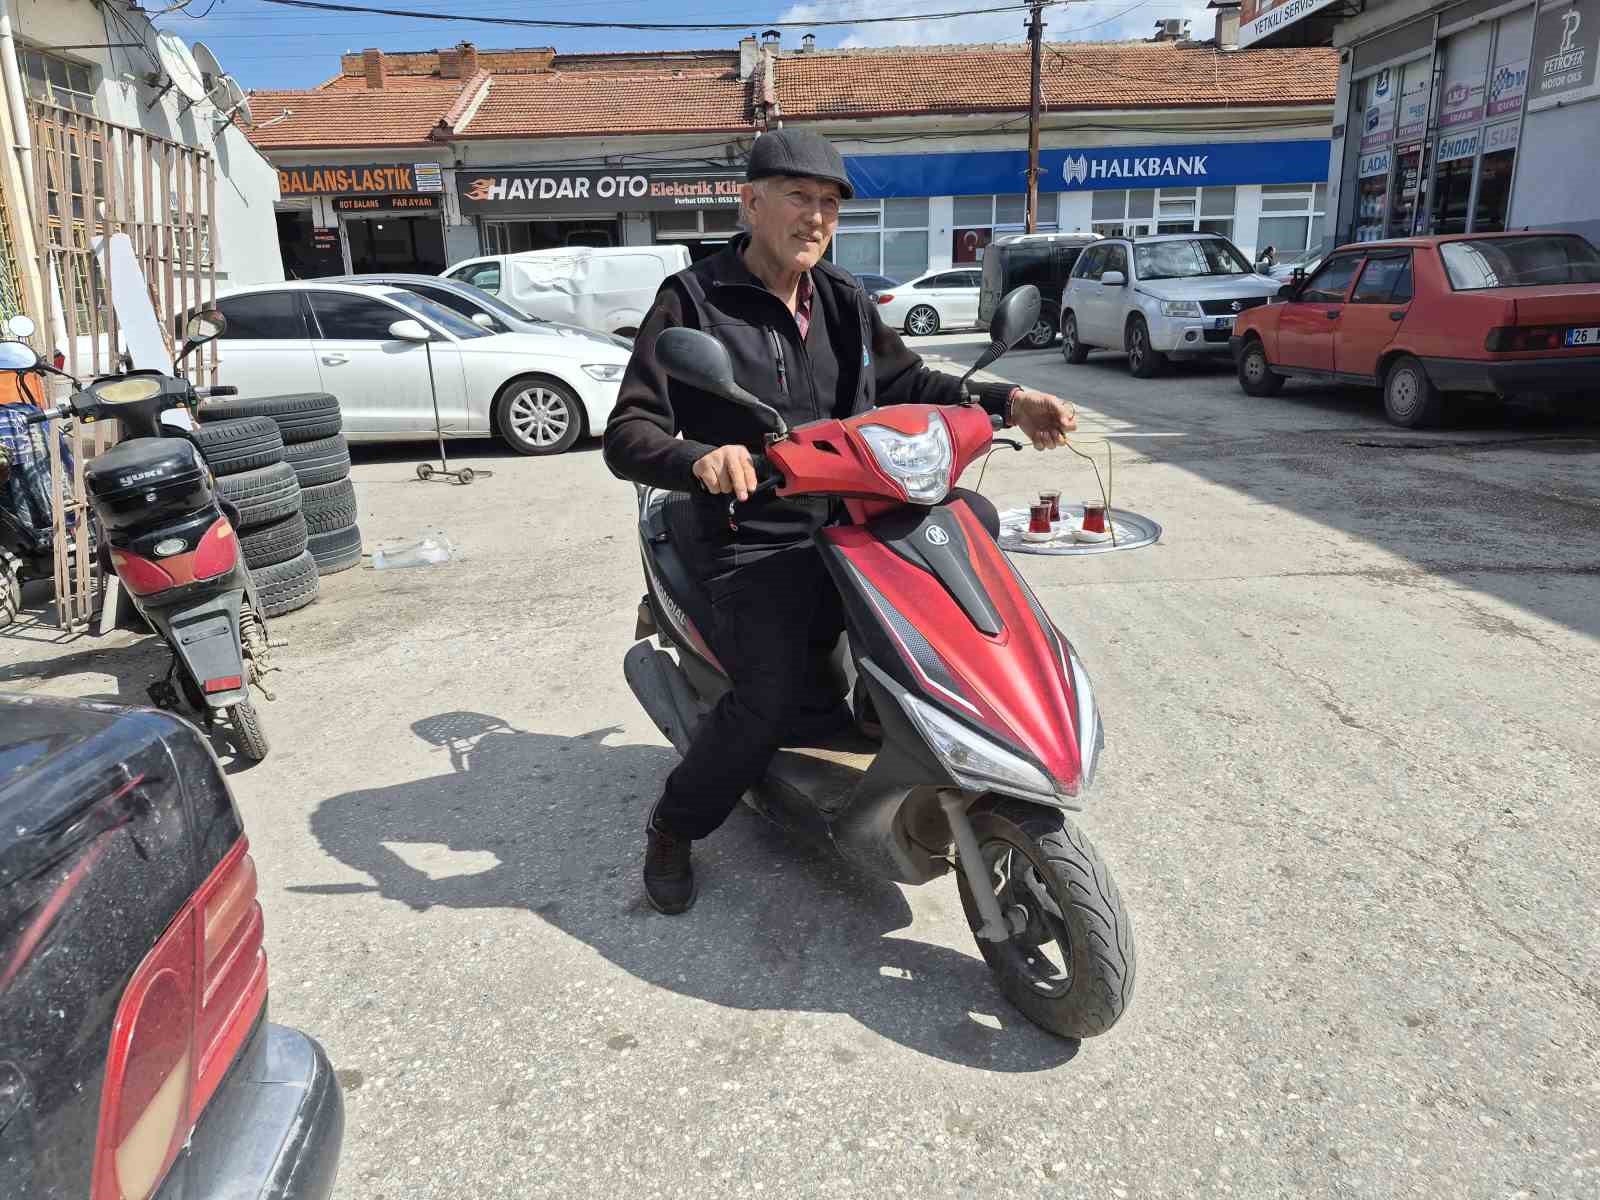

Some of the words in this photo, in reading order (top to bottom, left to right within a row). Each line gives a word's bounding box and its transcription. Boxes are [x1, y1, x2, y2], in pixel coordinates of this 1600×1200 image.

[1090, 155, 1209, 179] HALKBANK
[1361, 156, 1388, 174] LADA
[488, 176, 590, 200] HAYDAR
[596, 175, 648, 198] OTO
[650, 181, 712, 196] Elektrik
[392, 198, 408, 207] FAR
[409, 198, 432, 207] AYARI
[1573, 329, 1588, 343] 26
